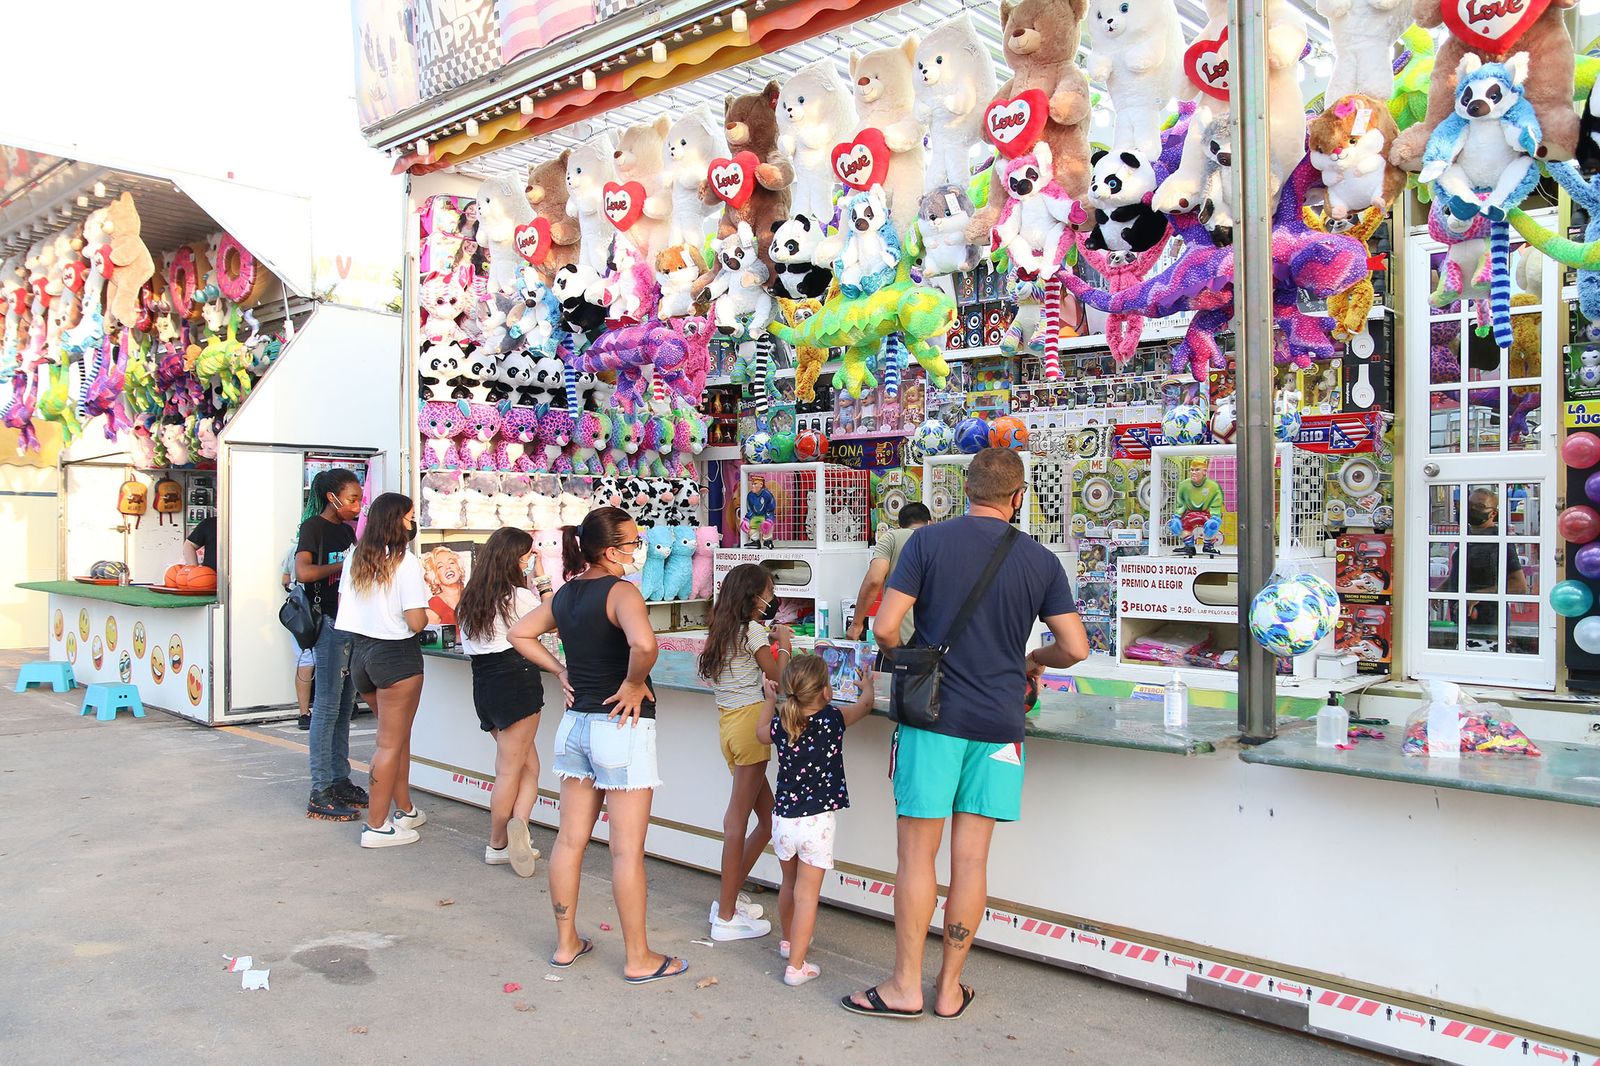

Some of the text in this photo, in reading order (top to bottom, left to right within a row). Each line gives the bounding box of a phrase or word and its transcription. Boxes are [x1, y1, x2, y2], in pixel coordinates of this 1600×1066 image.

[1466, 0, 1523, 24] Love
[421, 6, 492, 67] HAPPY
[1202, 60, 1229, 83] Lo
[991, 111, 1025, 132] Love
[839, 154, 871, 178] Love
[715, 172, 741, 190] Love
[606, 197, 628, 211] Love
[517, 234, 537, 249] Love
[1568, 404, 1586, 414] LA
[827, 445, 864, 458] ELONA
[1091, 461, 1103, 470] ME
[890, 472, 900, 482] ME
[715, 553, 737, 561] METIENDO
[1121, 564, 1197, 576] METIENDO 3 PELOTAS
[1121, 579, 1183, 590] PREMIO A ELEGIR
[1121, 600, 1129, 613] 3
[1130, 602, 1168, 613] PELOTAS
